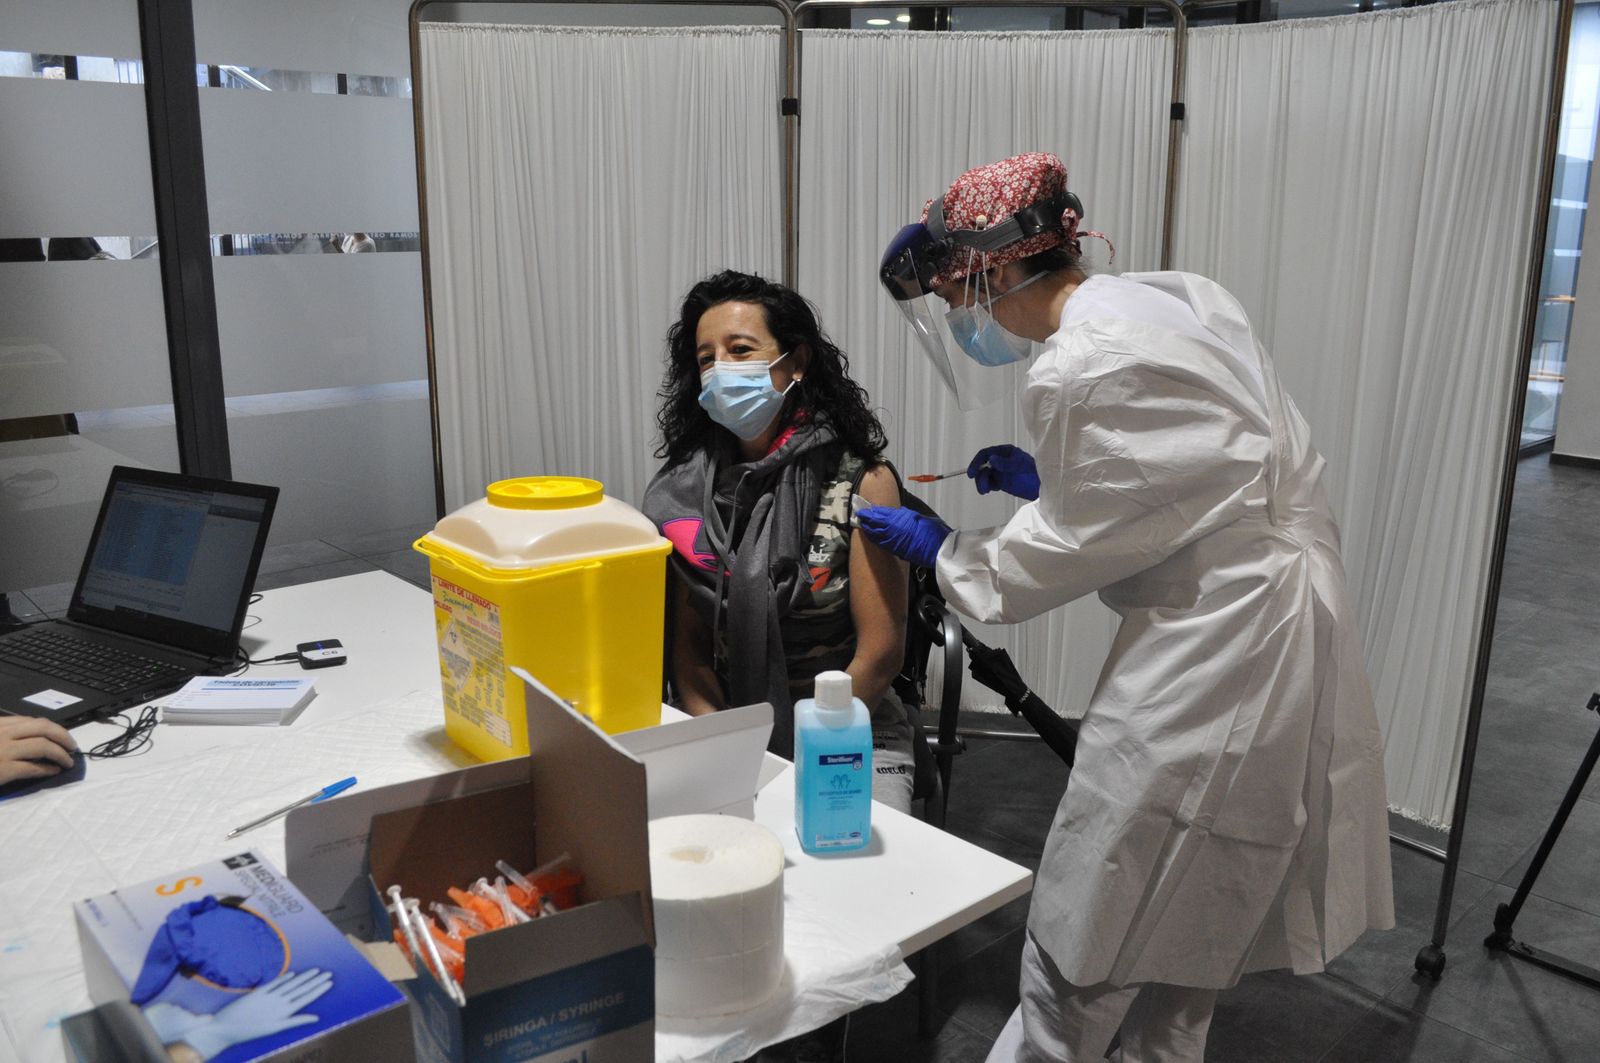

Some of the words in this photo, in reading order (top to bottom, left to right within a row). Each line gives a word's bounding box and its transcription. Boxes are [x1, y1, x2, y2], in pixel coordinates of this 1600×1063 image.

[154, 876, 203, 897] S
[250, 865, 304, 914] MEDIGUARD
[483, 1016, 547, 1048] SIRINGA
[558, 991, 625, 1022] SYRINGE
